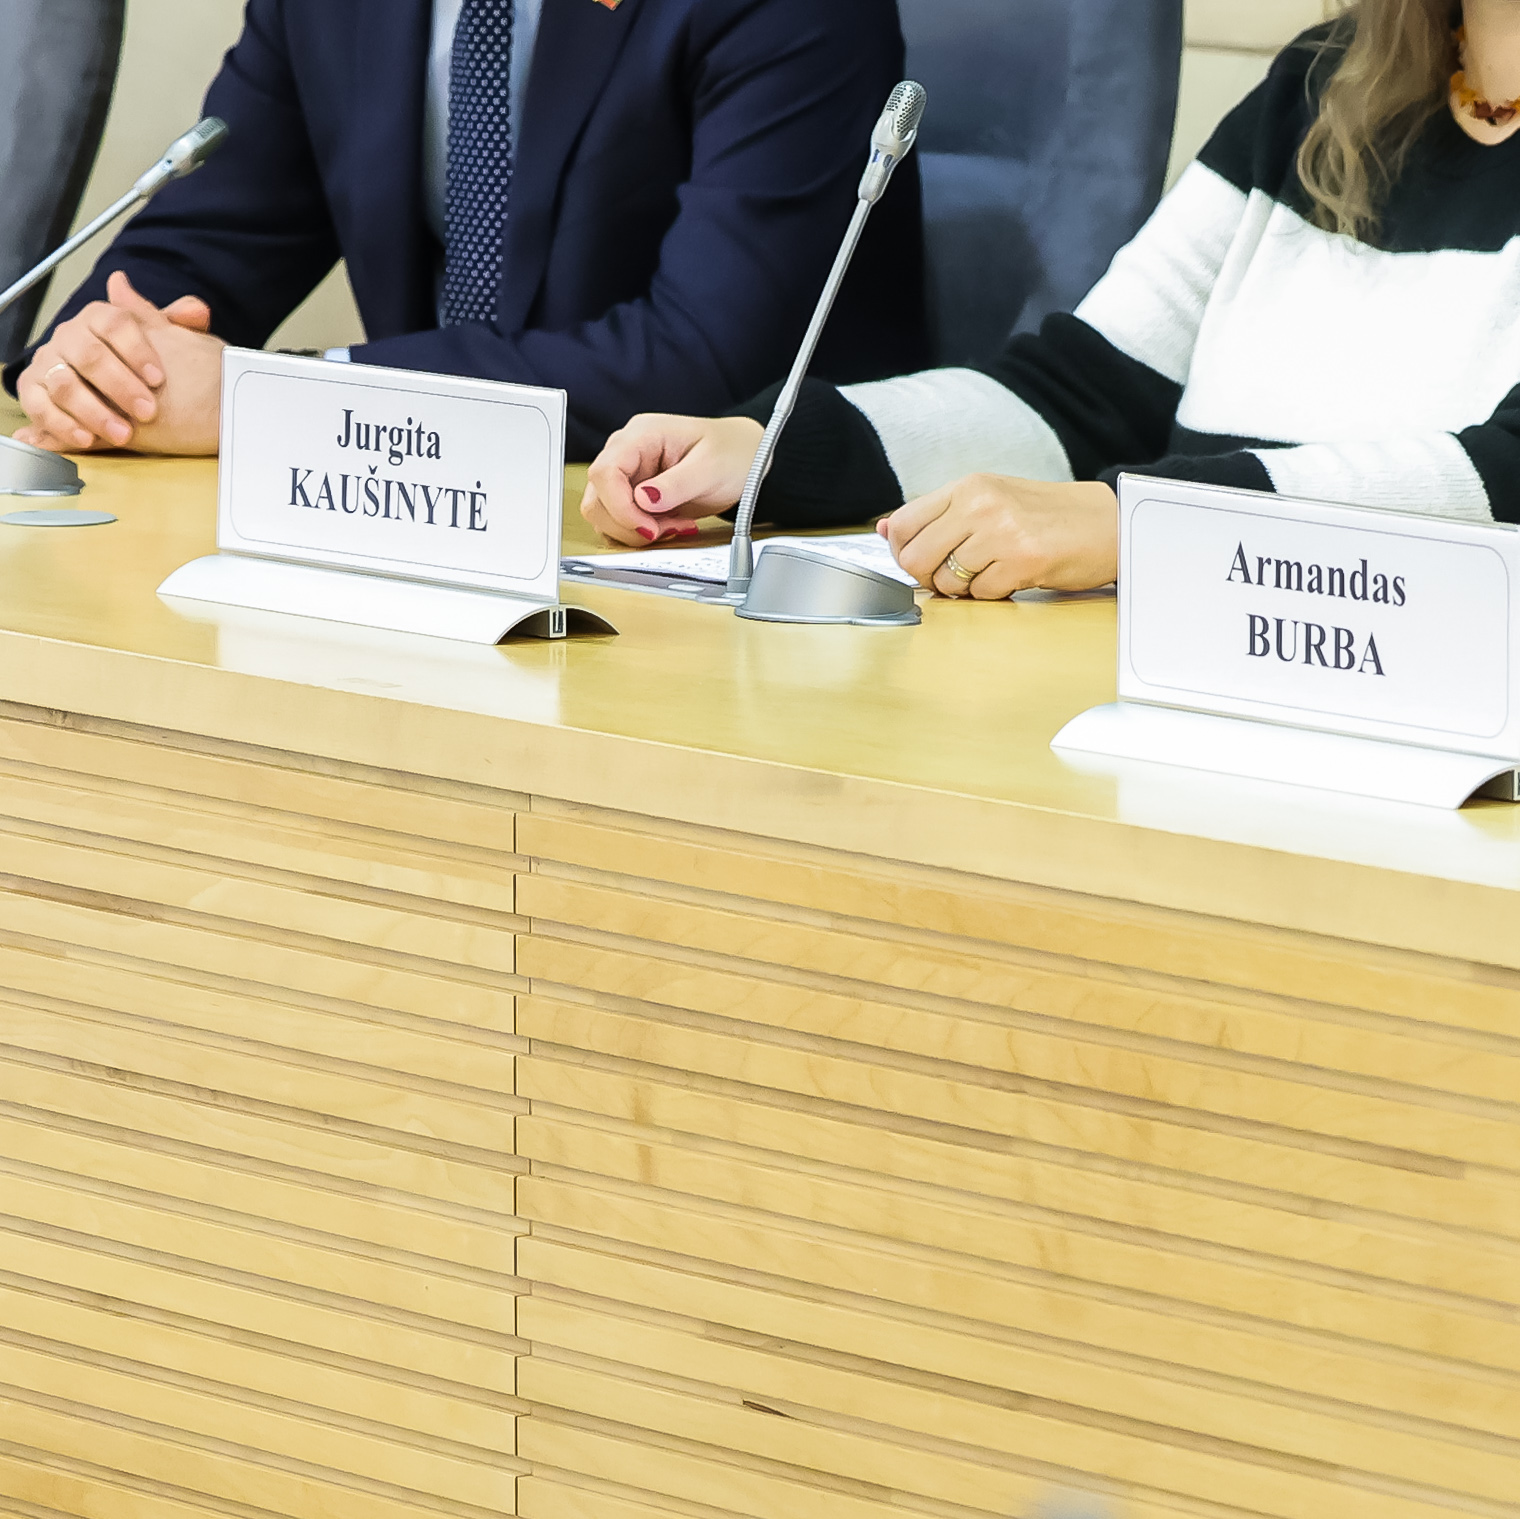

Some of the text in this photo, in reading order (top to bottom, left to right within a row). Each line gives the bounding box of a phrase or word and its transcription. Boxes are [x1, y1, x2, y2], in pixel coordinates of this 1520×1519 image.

[336, 408, 442, 467] Jurgita
[288, 464, 488, 533] KAUŠINYTĖ
[1225, 540, 1407, 608] Armandas
[1245, 612, 1387, 677] BURBA
